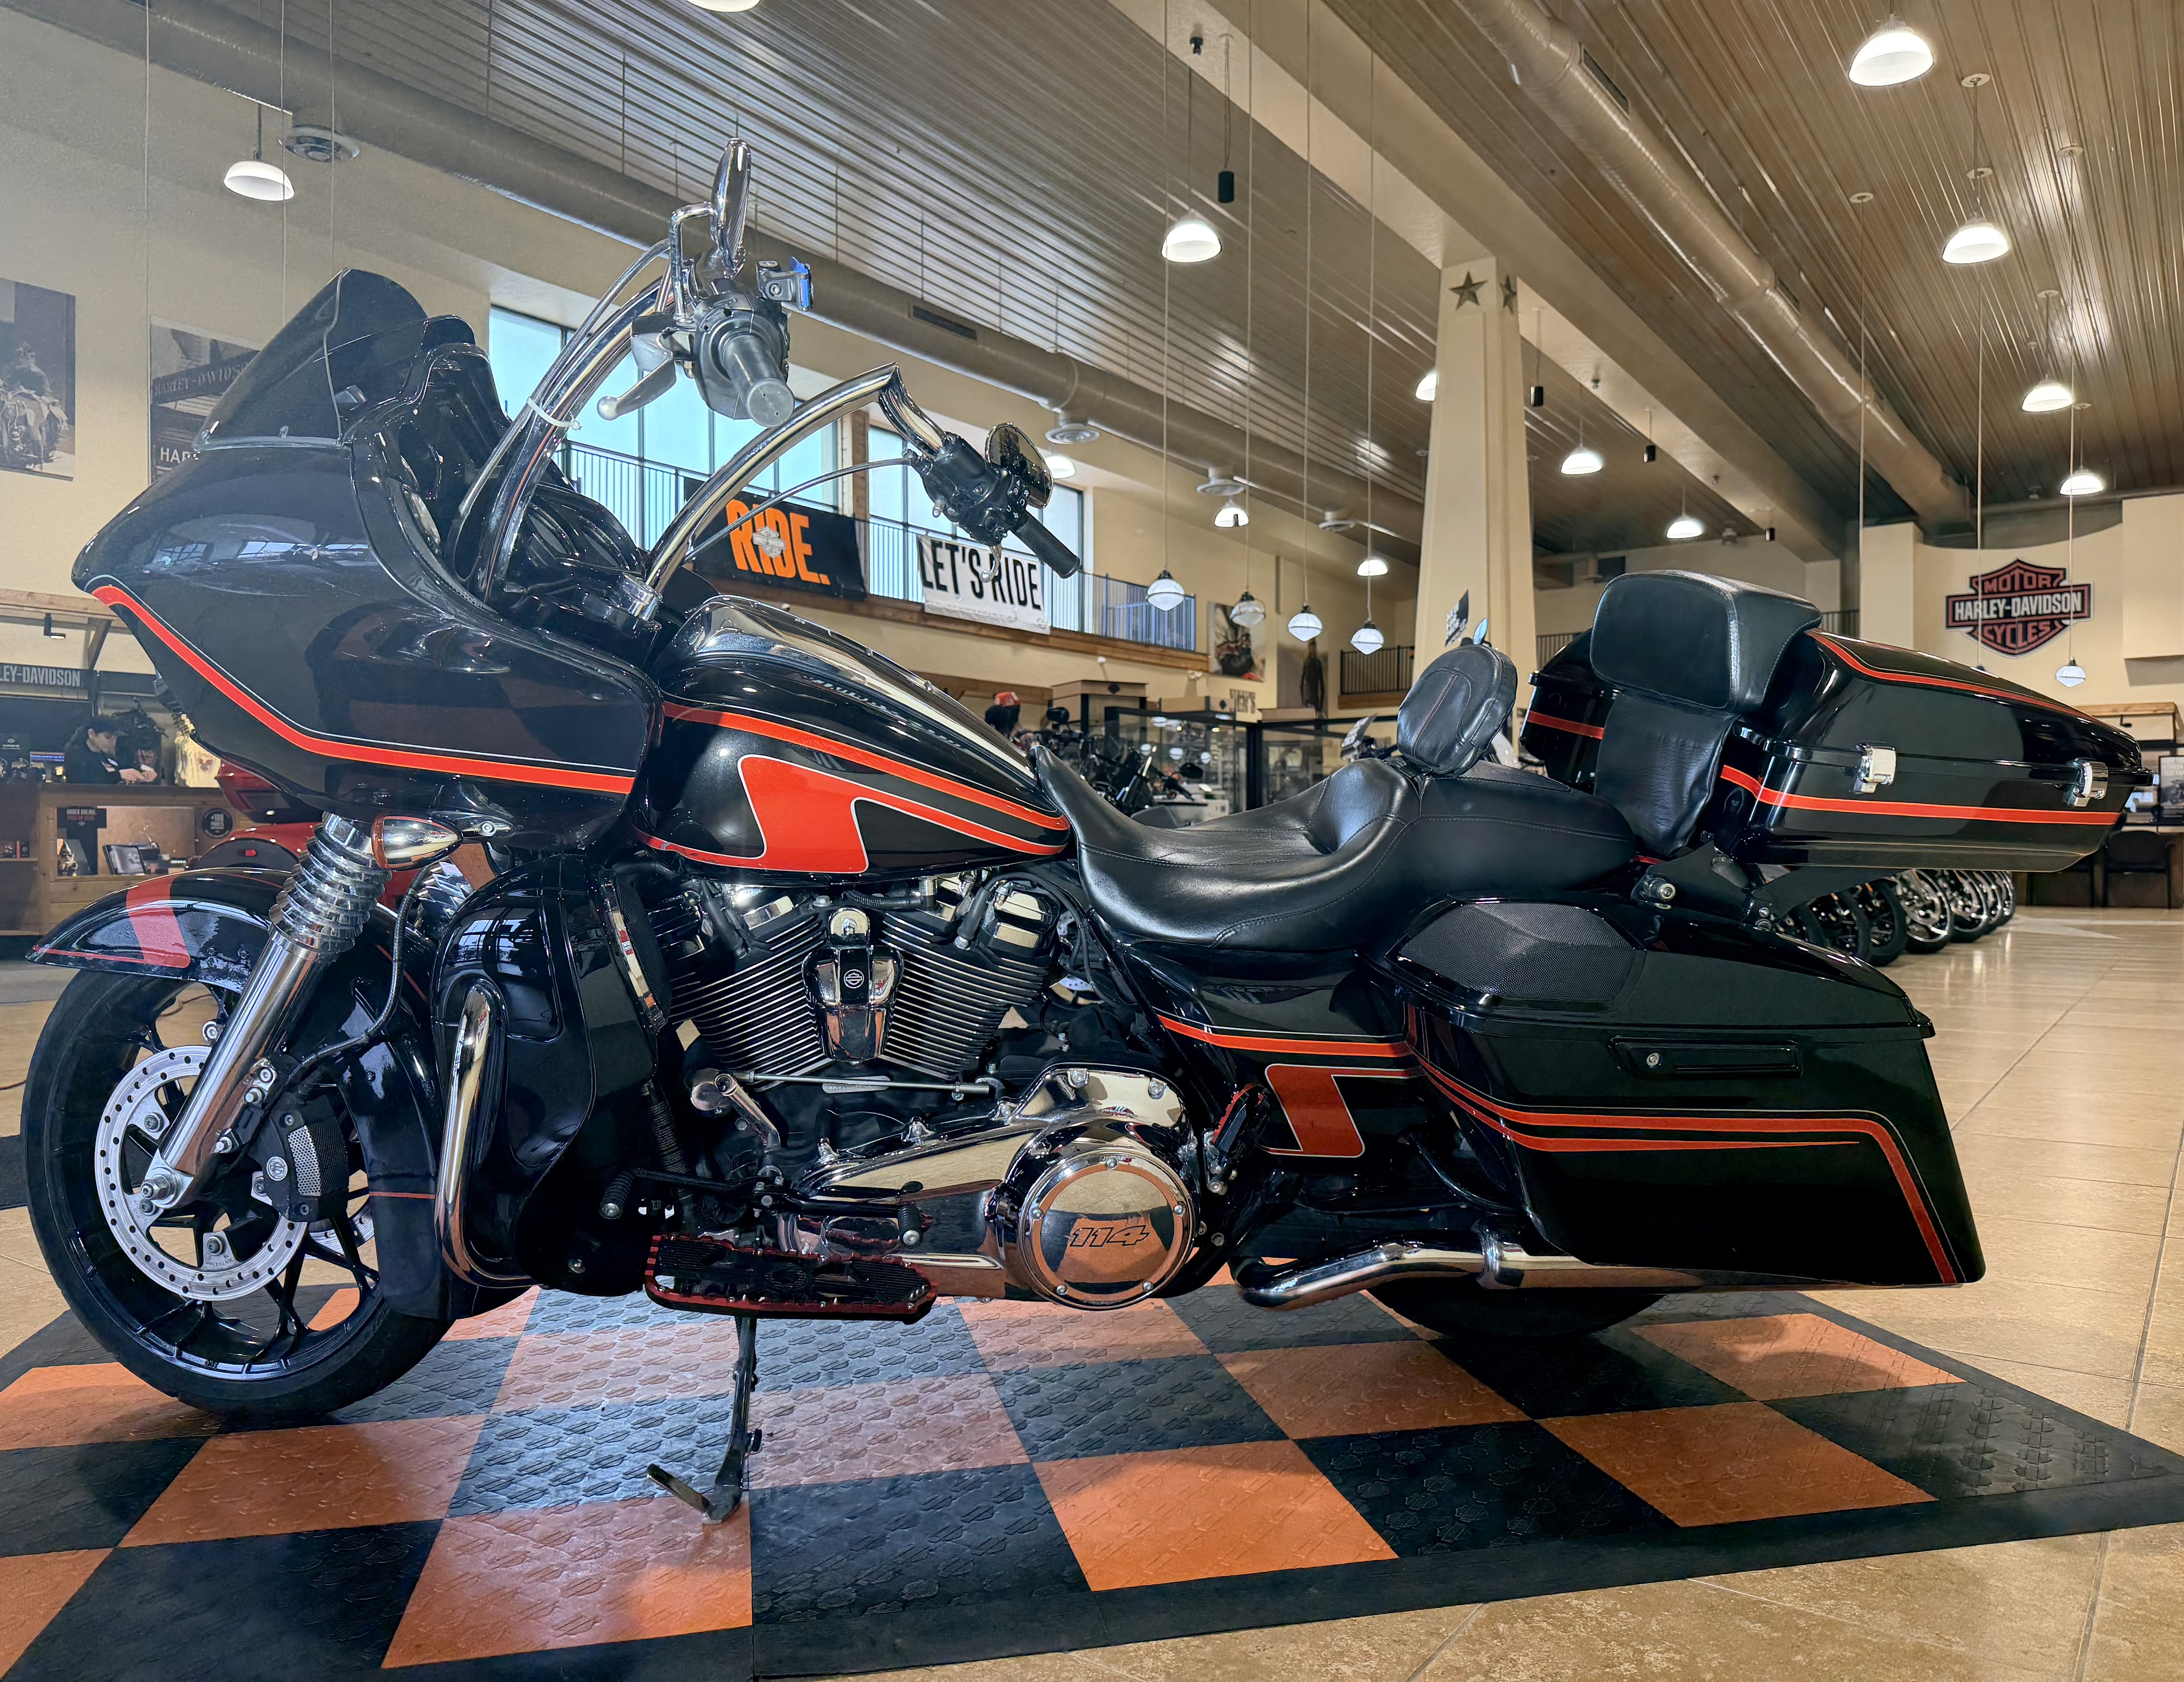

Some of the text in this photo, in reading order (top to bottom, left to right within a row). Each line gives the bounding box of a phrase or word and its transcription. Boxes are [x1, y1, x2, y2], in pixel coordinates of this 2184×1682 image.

[155, 362, 248, 395] HARLEY-DAVIDS
[918, 539, 1042, 611] LET'S RIDE
[1983, 569, 2052, 593] MOTOR
[1954, 591, 2082, 621] HARLEY-DAVIDSON
[1983, 620, 2050, 648] CYCLES
[1070, 1225, 1150, 1247] 114
